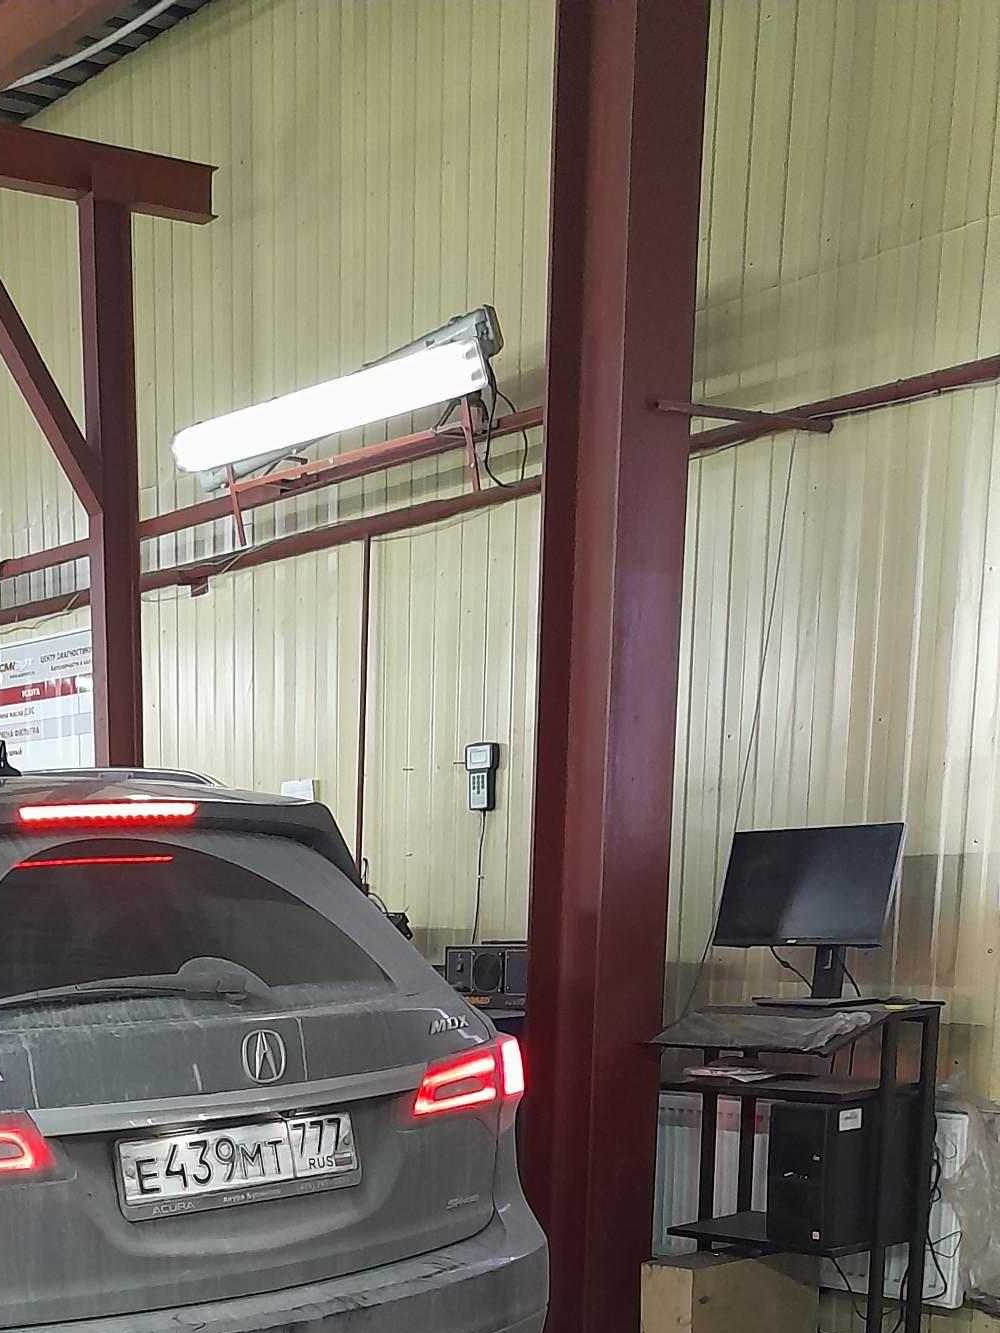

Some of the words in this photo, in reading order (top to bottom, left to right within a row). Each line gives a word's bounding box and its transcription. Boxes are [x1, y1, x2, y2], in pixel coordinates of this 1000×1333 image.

[429, 1015, 469, 1035] MDX
[291, 1117, 342, 1157] 777
[308, 1155, 334, 1171] RUS
[151, 1201, 197, 1216] ACURA
